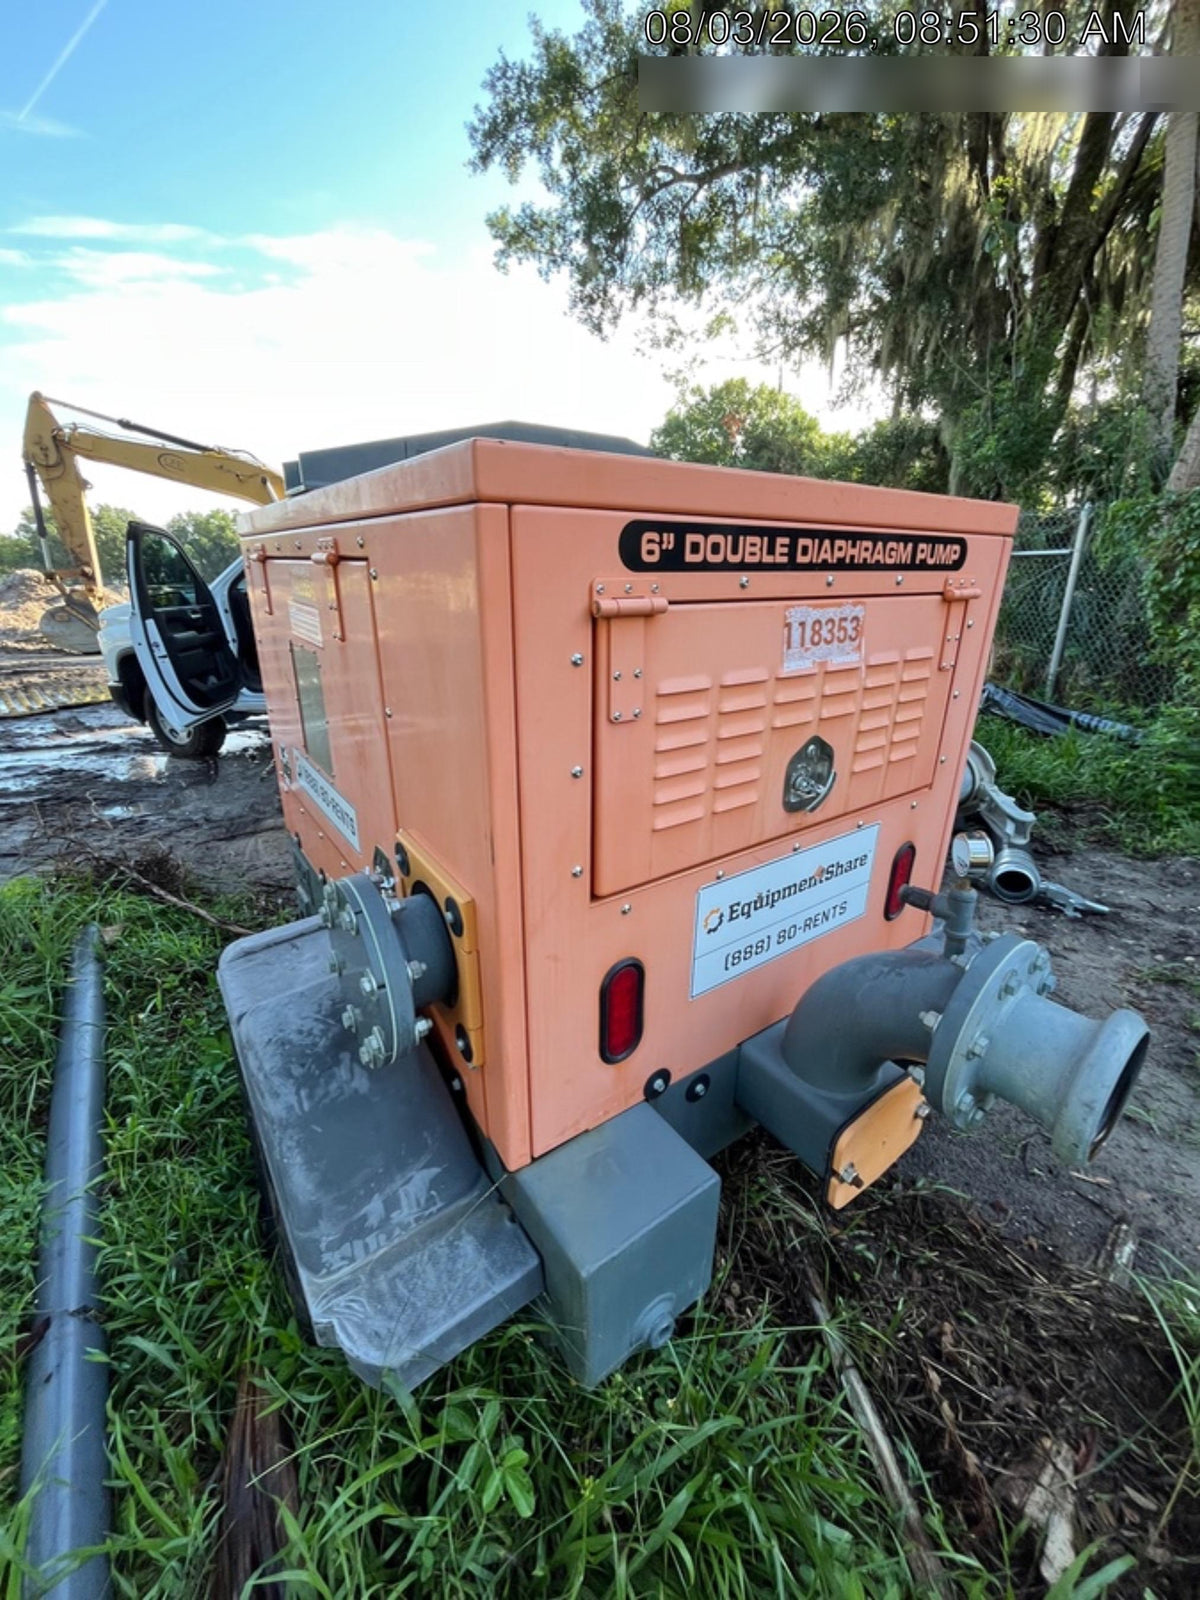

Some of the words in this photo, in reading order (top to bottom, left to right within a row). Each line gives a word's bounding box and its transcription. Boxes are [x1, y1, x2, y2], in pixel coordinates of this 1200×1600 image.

[684, 533, 790, 564] DOUBLE
[795, 536, 912, 565] DIAPHRAGM
[914, 542, 962, 566] PUMP
[784, 615, 861, 650] 118353
[724, 935, 771, 972] (888)
[776, 900, 848, 946] 80-RENTS
